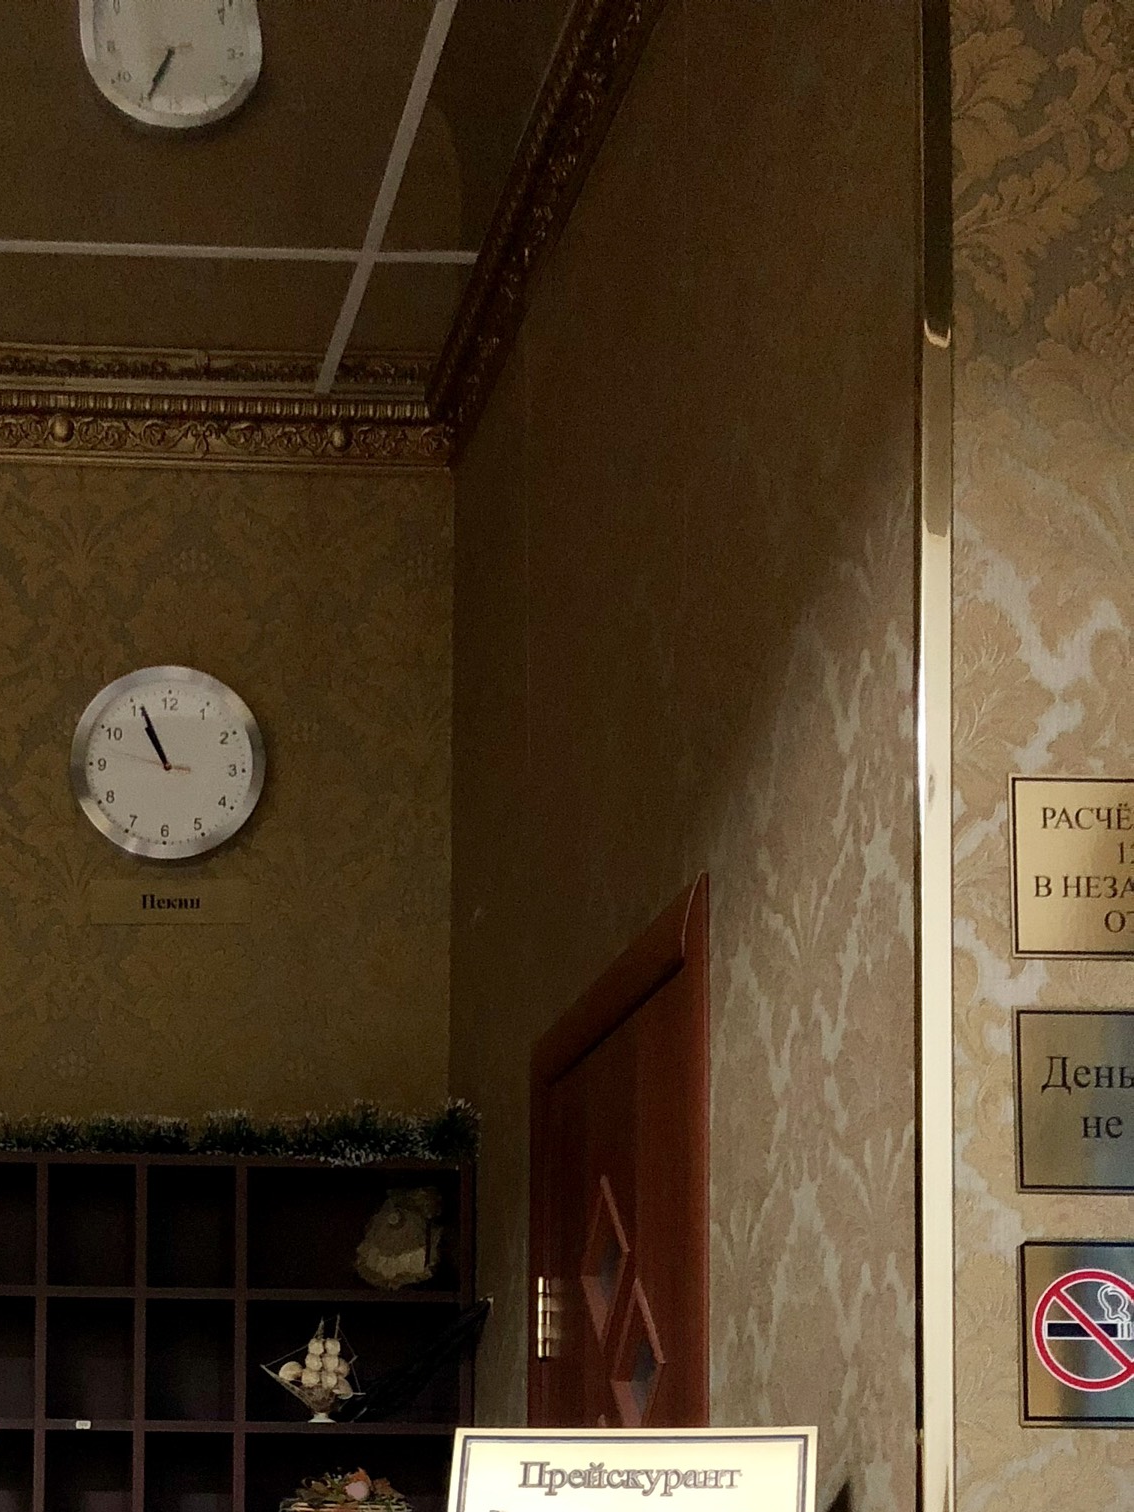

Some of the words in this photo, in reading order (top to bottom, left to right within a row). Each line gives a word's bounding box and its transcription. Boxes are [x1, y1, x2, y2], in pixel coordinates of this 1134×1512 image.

[162, 697, 179, 711] 12
[199, 708, 205, 720] 1
[106, 727, 123, 740] 10
[219, 732, 229, 745] 2
[97, 758, 107, 771] 9
[228, 764, 237, 777] 3
[105, 790, 115, 803] 8
[218, 796, 227, 808] 4
[129, 815, 138, 828] 7
[193, 818, 202, 831] 5
[160, 824, 169, 837] 6
[1117, 842, 1134, 864] 1
[1034, 875, 1053, 898] В
[140, 893, 201, 910] Пекин
[1040, 1056, 1134, 1096] День
[1080, 1116, 1124, 1139] не
[518, 1461, 742, 1497] Прейскурант
